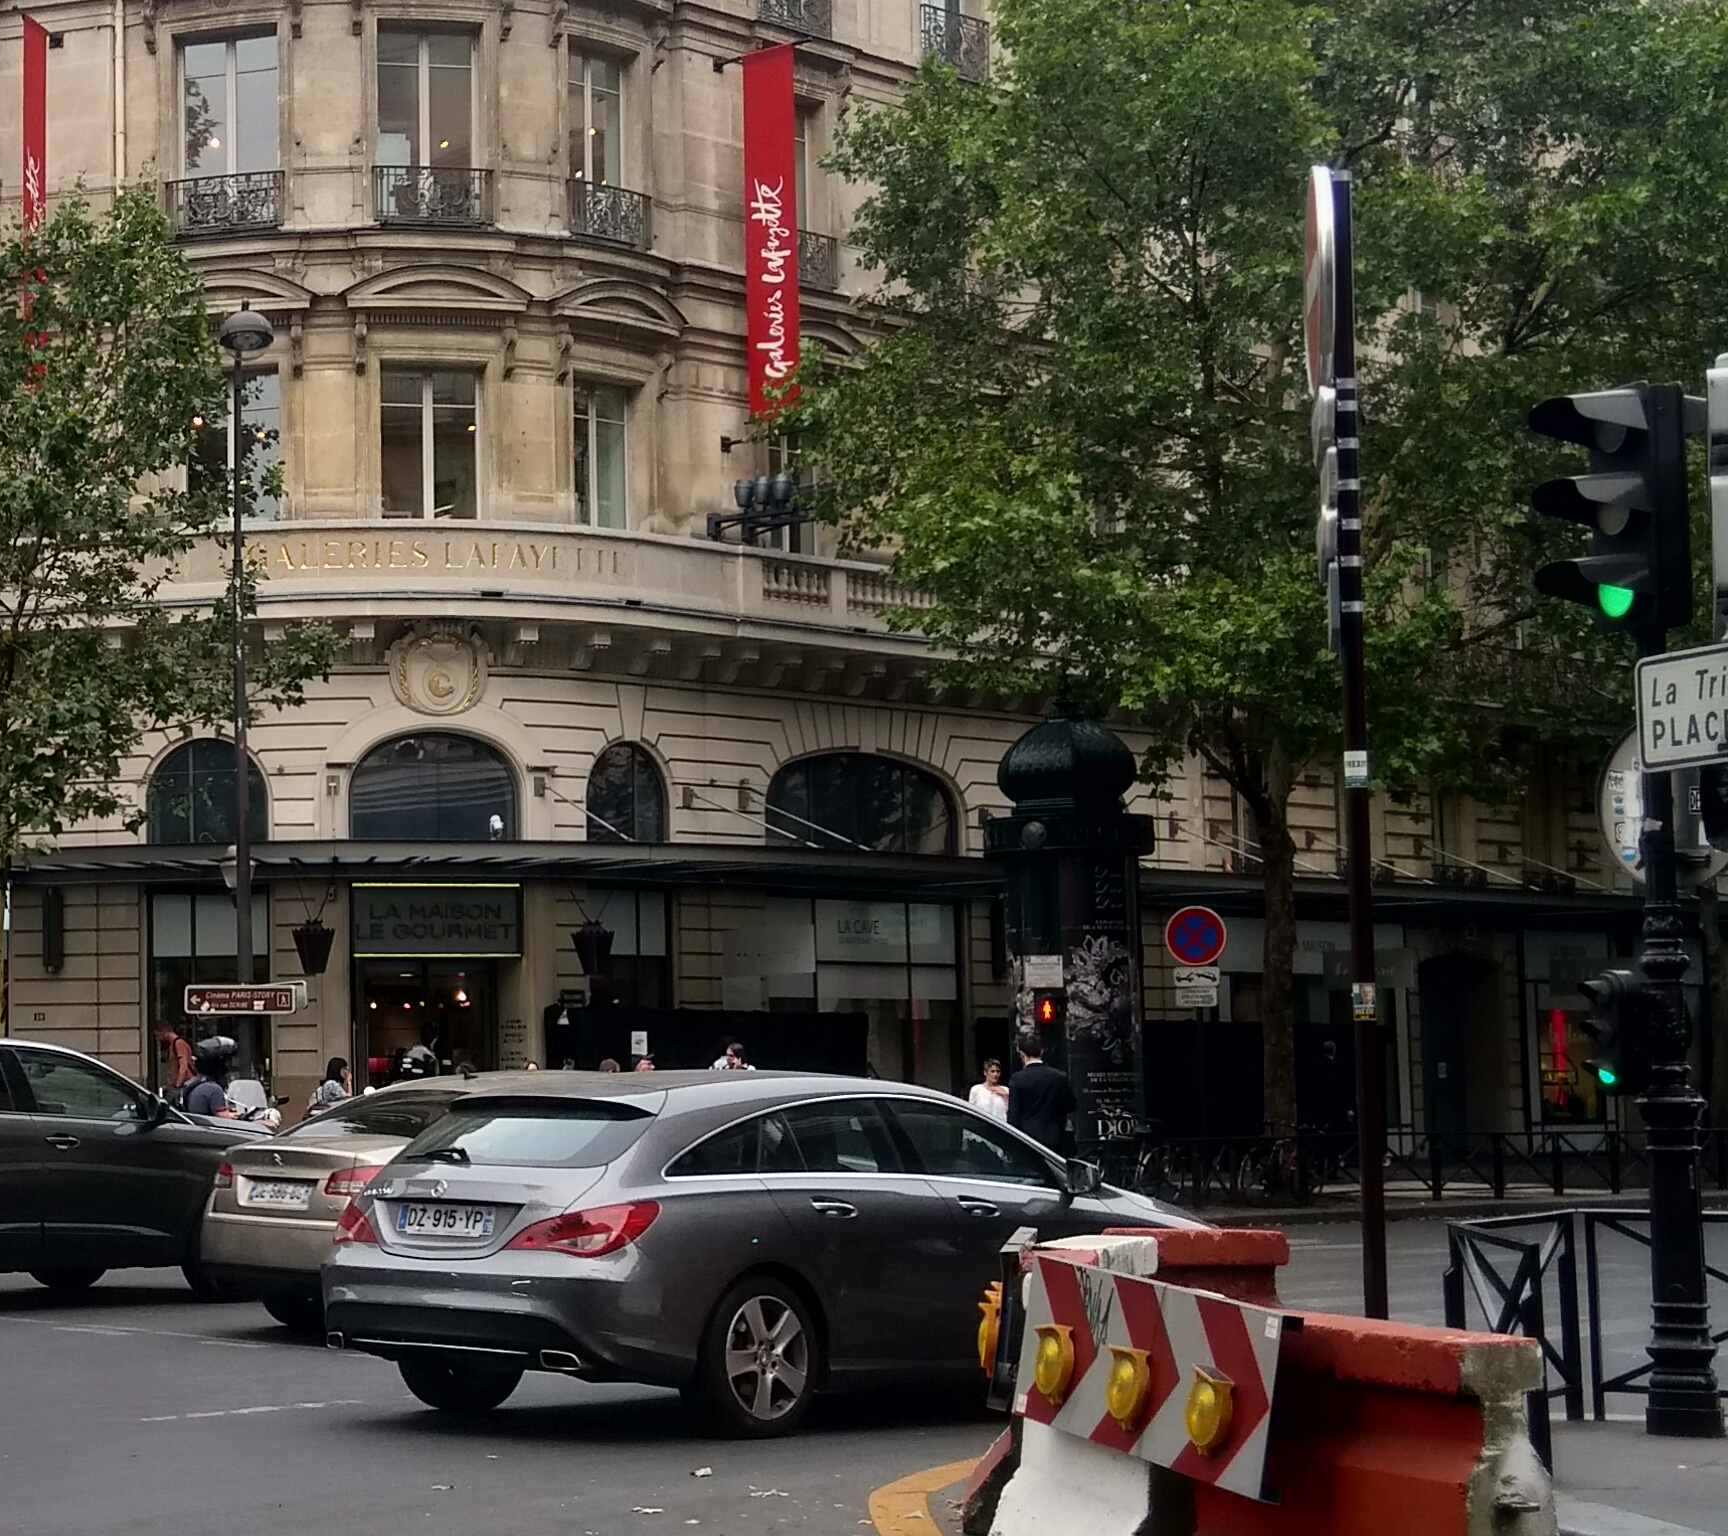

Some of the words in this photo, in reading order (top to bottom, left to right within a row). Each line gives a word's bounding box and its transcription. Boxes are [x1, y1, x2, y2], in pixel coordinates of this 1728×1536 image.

[750, 174, 791, 284] Lafayette
[756, 288, 795, 379] Galeries
[245, 540, 430, 570] GALERIES
[444, 541, 628, 576] LAFAYETTE
[1651, 677, 1677, 708] La
[369, 902, 401, 920] LA
[409, 902, 502, 920] MAISON
[355, 923, 384, 939] LE
[392, 923, 515, 939] GOURMET
[837, 919, 852, 934] LA
[853, 919, 881, 936] CAVE
[205, 991, 230, 999] Cinéma
[407, 1208, 485, 1230] DZ-915-YP
